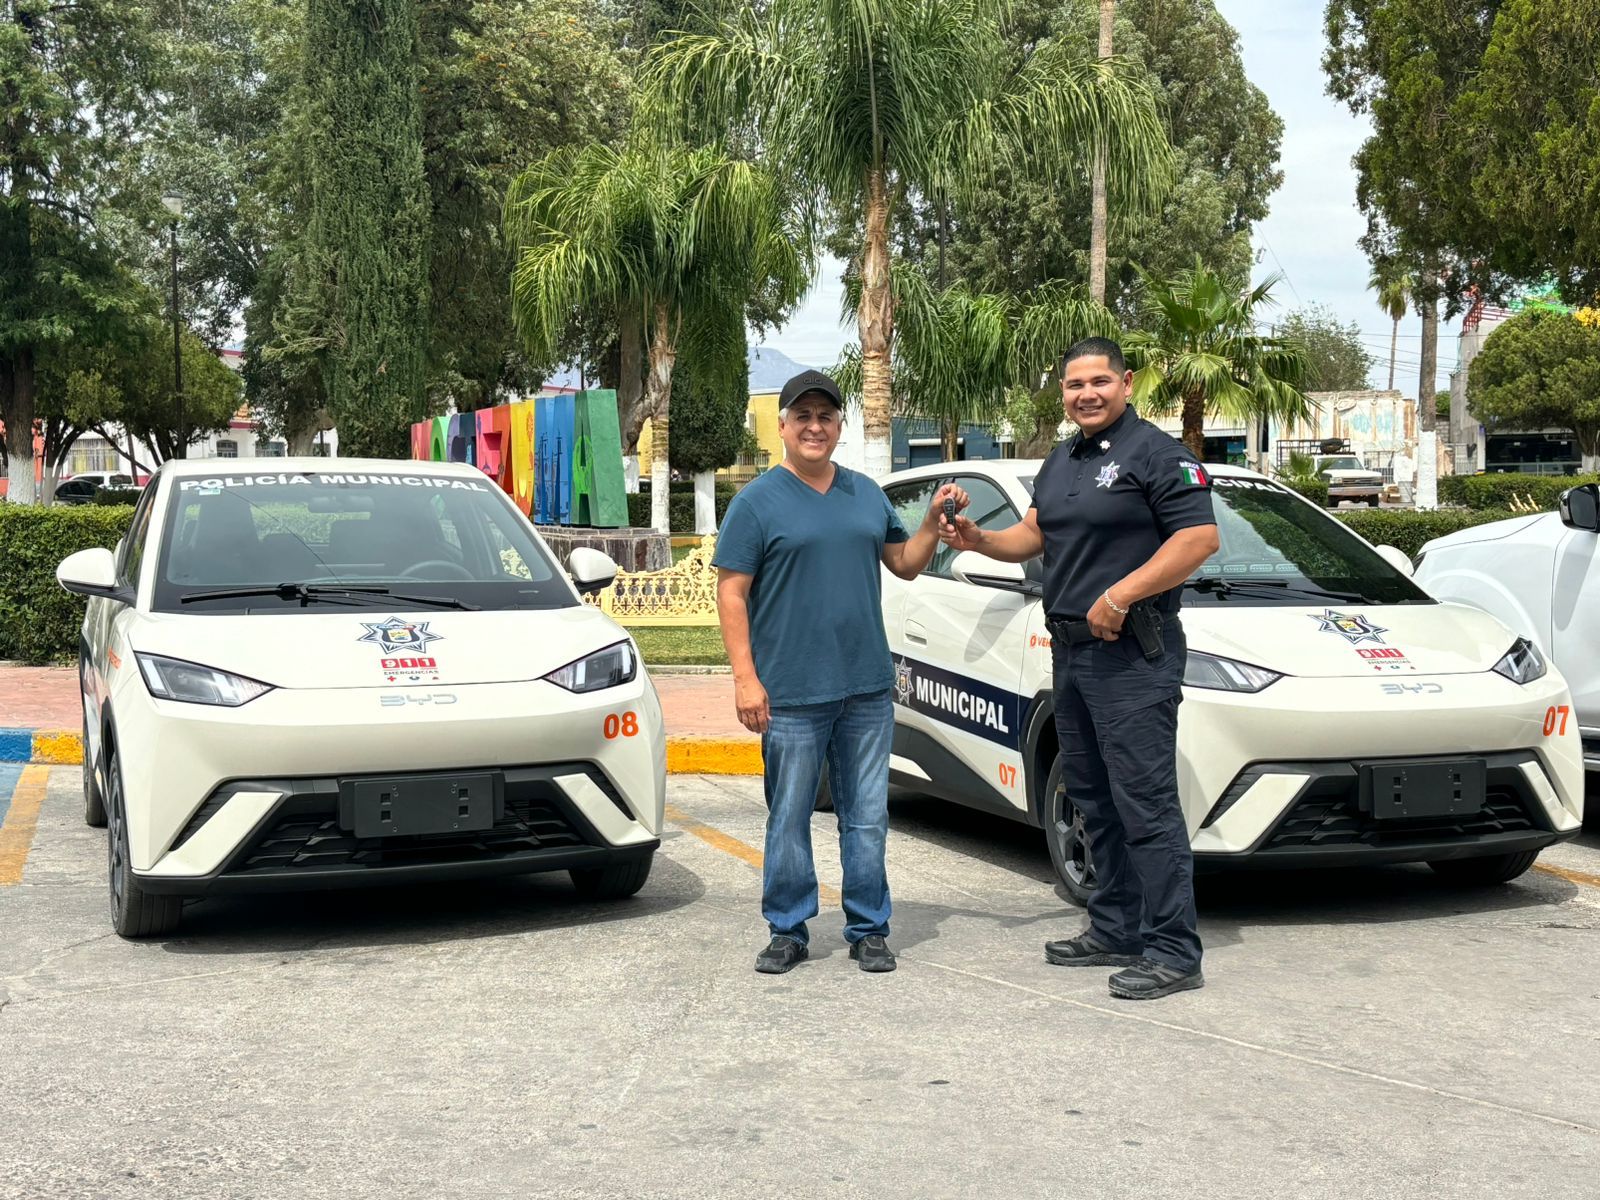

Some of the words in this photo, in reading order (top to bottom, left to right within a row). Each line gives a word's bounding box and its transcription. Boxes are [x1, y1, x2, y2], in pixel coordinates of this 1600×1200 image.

[180, 474, 312, 491] POLICÍA
[319, 474, 488, 492] MUNICIPAL
[1356, 648, 1405, 658] 911
[381, 658, 436, 668] 911
[1380, 682, 1444, 695] BYD
[380, 693, 458, 707] BYD
[916, 675, 1009, 734] MUNICIPAL
[603, 711, 639, 740] 08
[1542, 705, 1570, 737] 07
[998, 762, 1017, 788] 07
